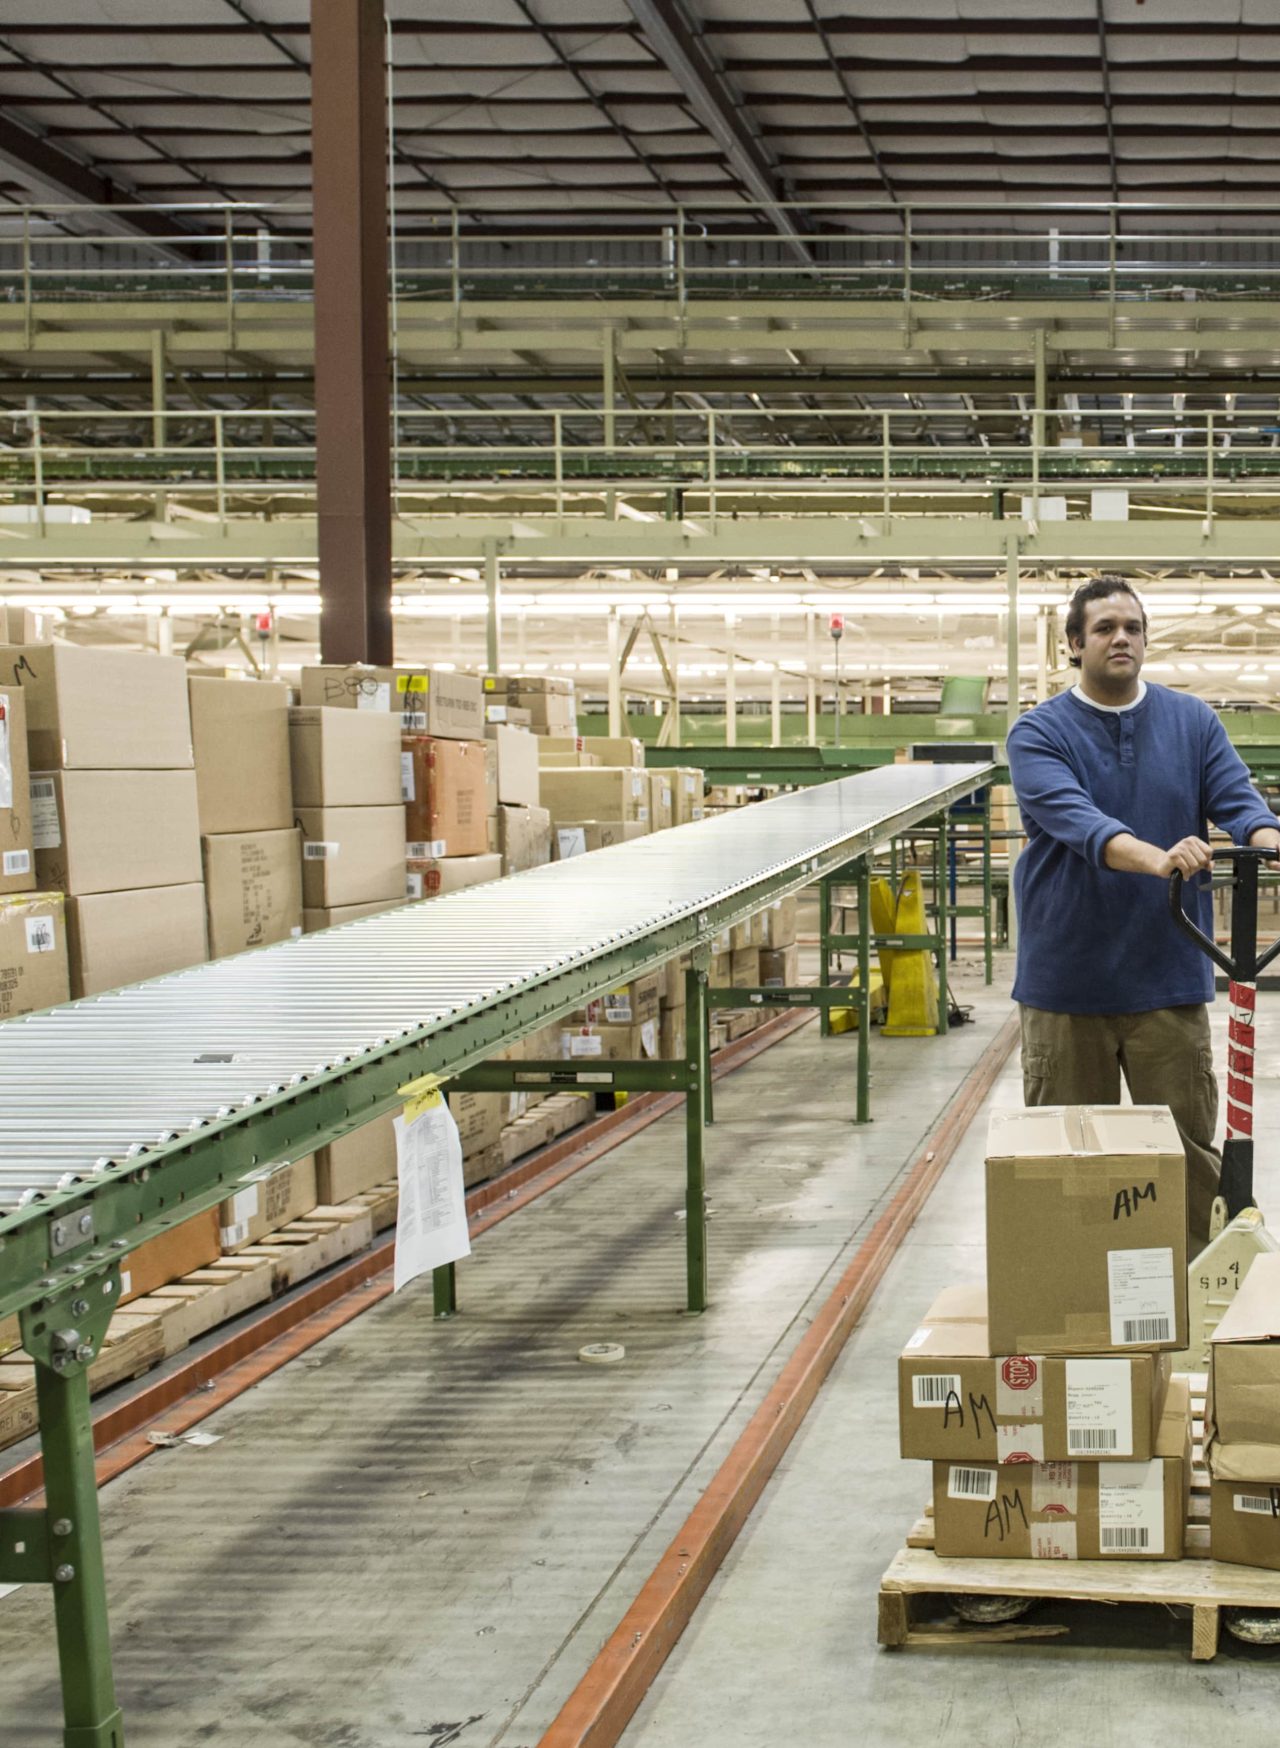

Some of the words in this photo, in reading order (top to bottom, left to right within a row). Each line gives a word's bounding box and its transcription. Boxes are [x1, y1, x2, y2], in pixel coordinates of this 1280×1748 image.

[1113, 1182, 1157, 1220] AM
[1009, 1360, 1030, 1385] STOP
[943, 1390, 998, 1440] AM
[984, 1488, 1029, 1541] AM
